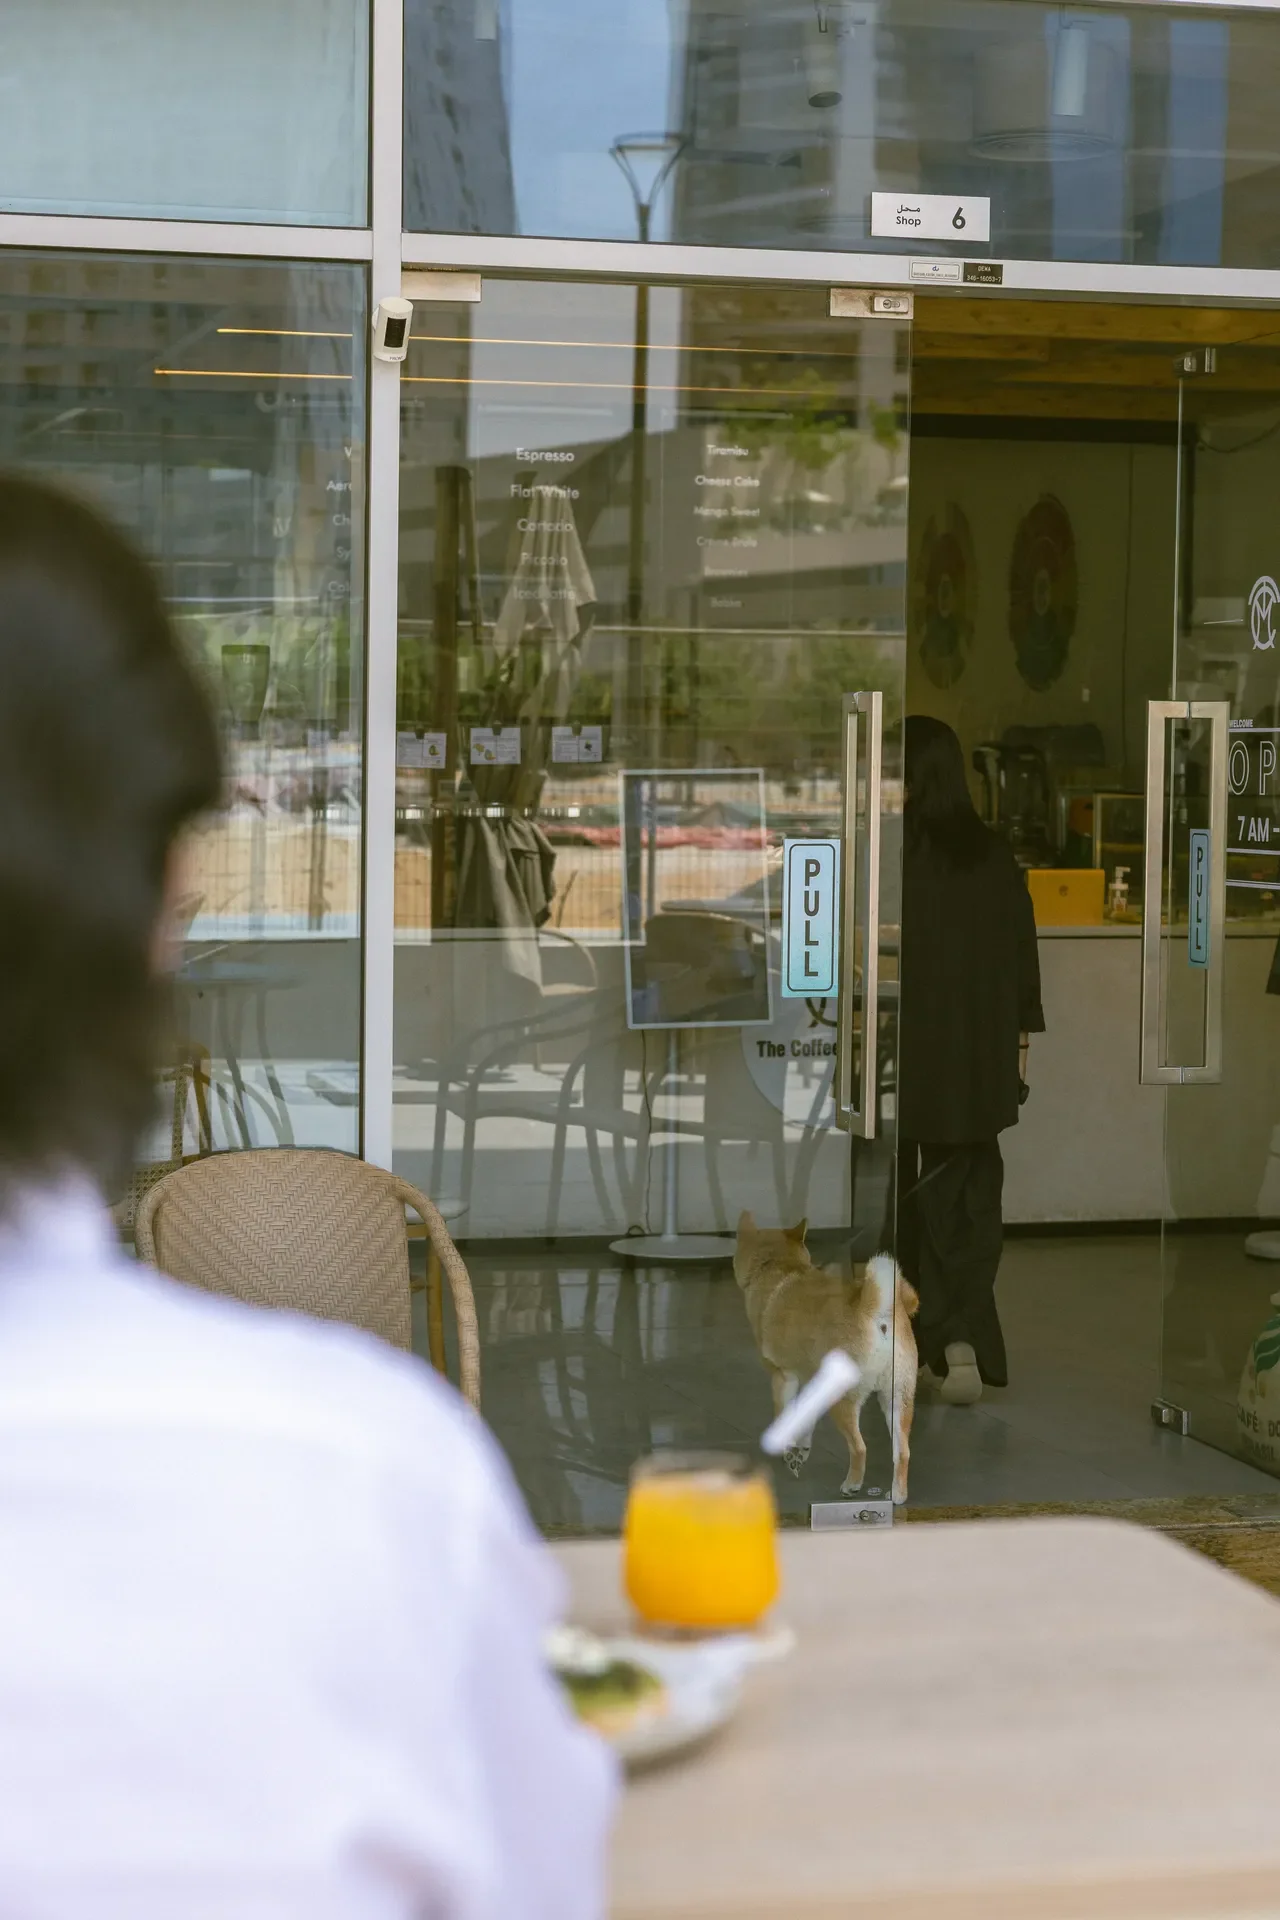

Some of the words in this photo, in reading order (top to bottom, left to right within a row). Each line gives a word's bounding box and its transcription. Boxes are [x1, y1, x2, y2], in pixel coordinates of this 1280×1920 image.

[896, 204, 921, 214] محل
[896, 216, 921, 227] Shop
[952, 207, 966, 229] 6
[516, 448, 575, 464] Espresso
[510, 484, 537, 498] Flat
[540, 486, 580, 499] White
[1229, 719, 1254, 728] WELCOME
[1195, 847, 1204, 950] PULL
[803, 859, 821, 977] PULL
[757, 1040, 785, 1057] The
